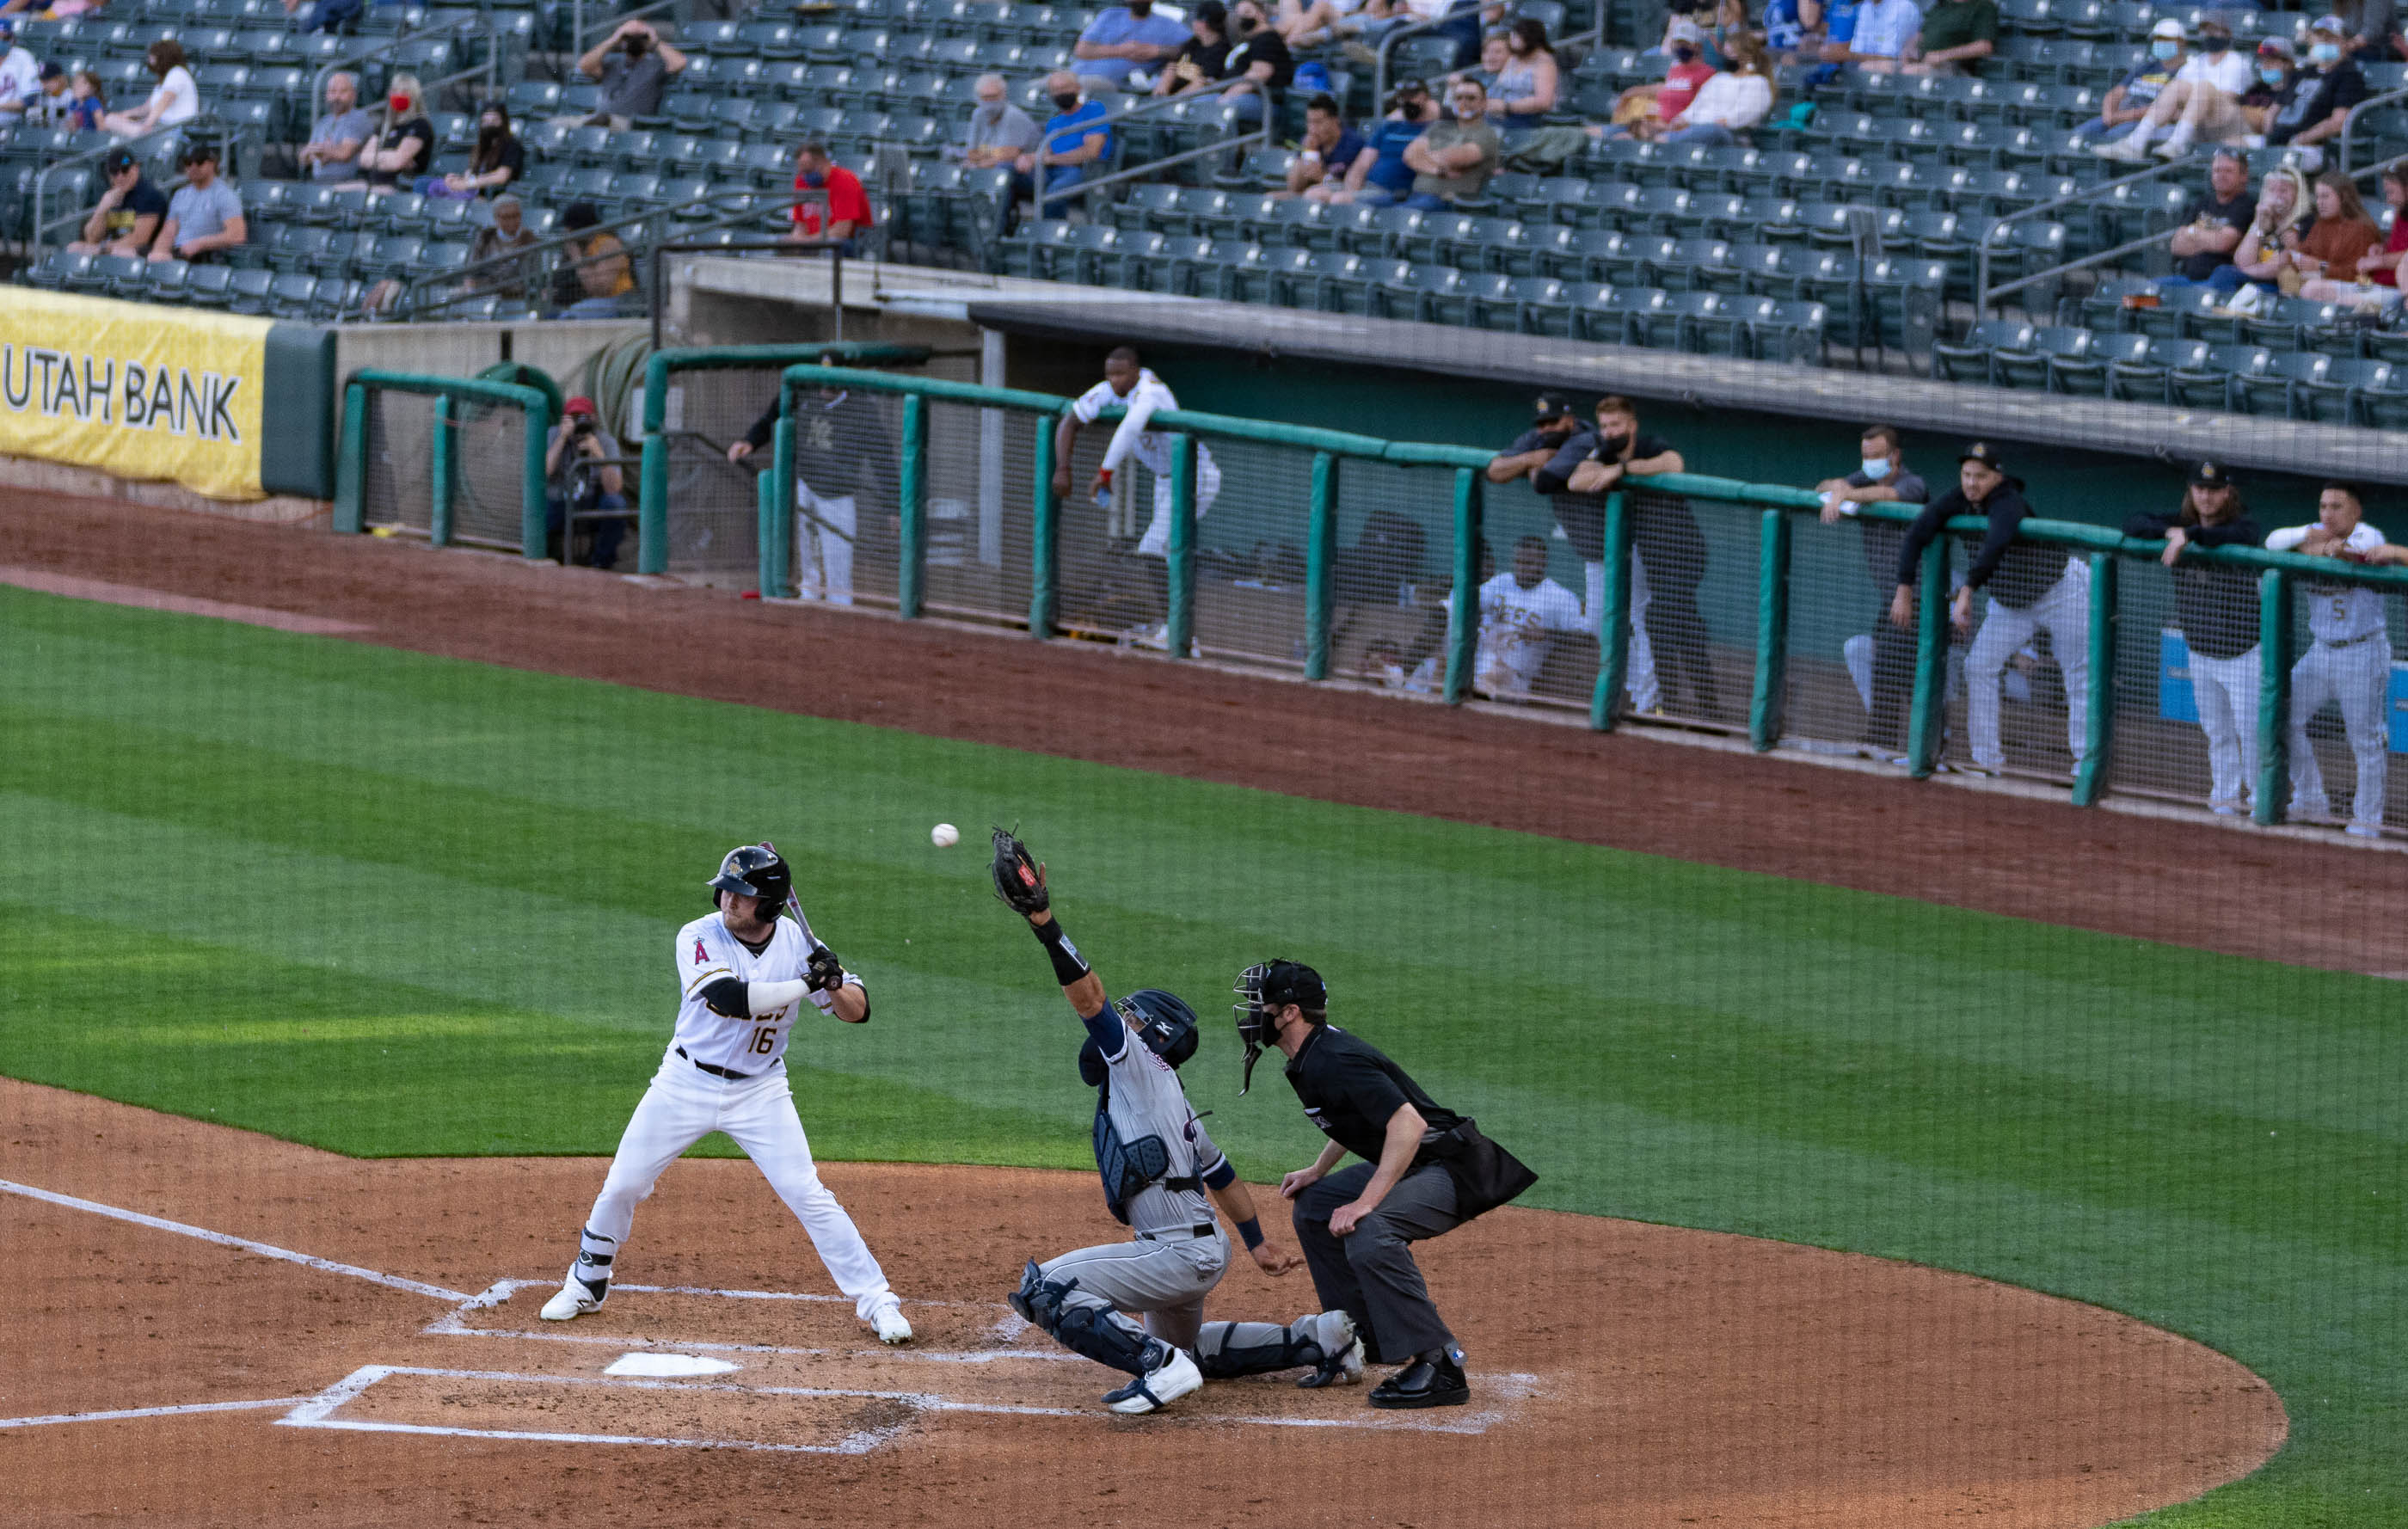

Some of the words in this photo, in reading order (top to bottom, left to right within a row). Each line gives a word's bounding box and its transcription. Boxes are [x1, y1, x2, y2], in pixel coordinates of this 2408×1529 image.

[3, 344, 114, 425] UTAH
[123, 359, 242, 445] BANK
[694, 936, 710, 965] A
[747, 1026, 777, 1054] 16
